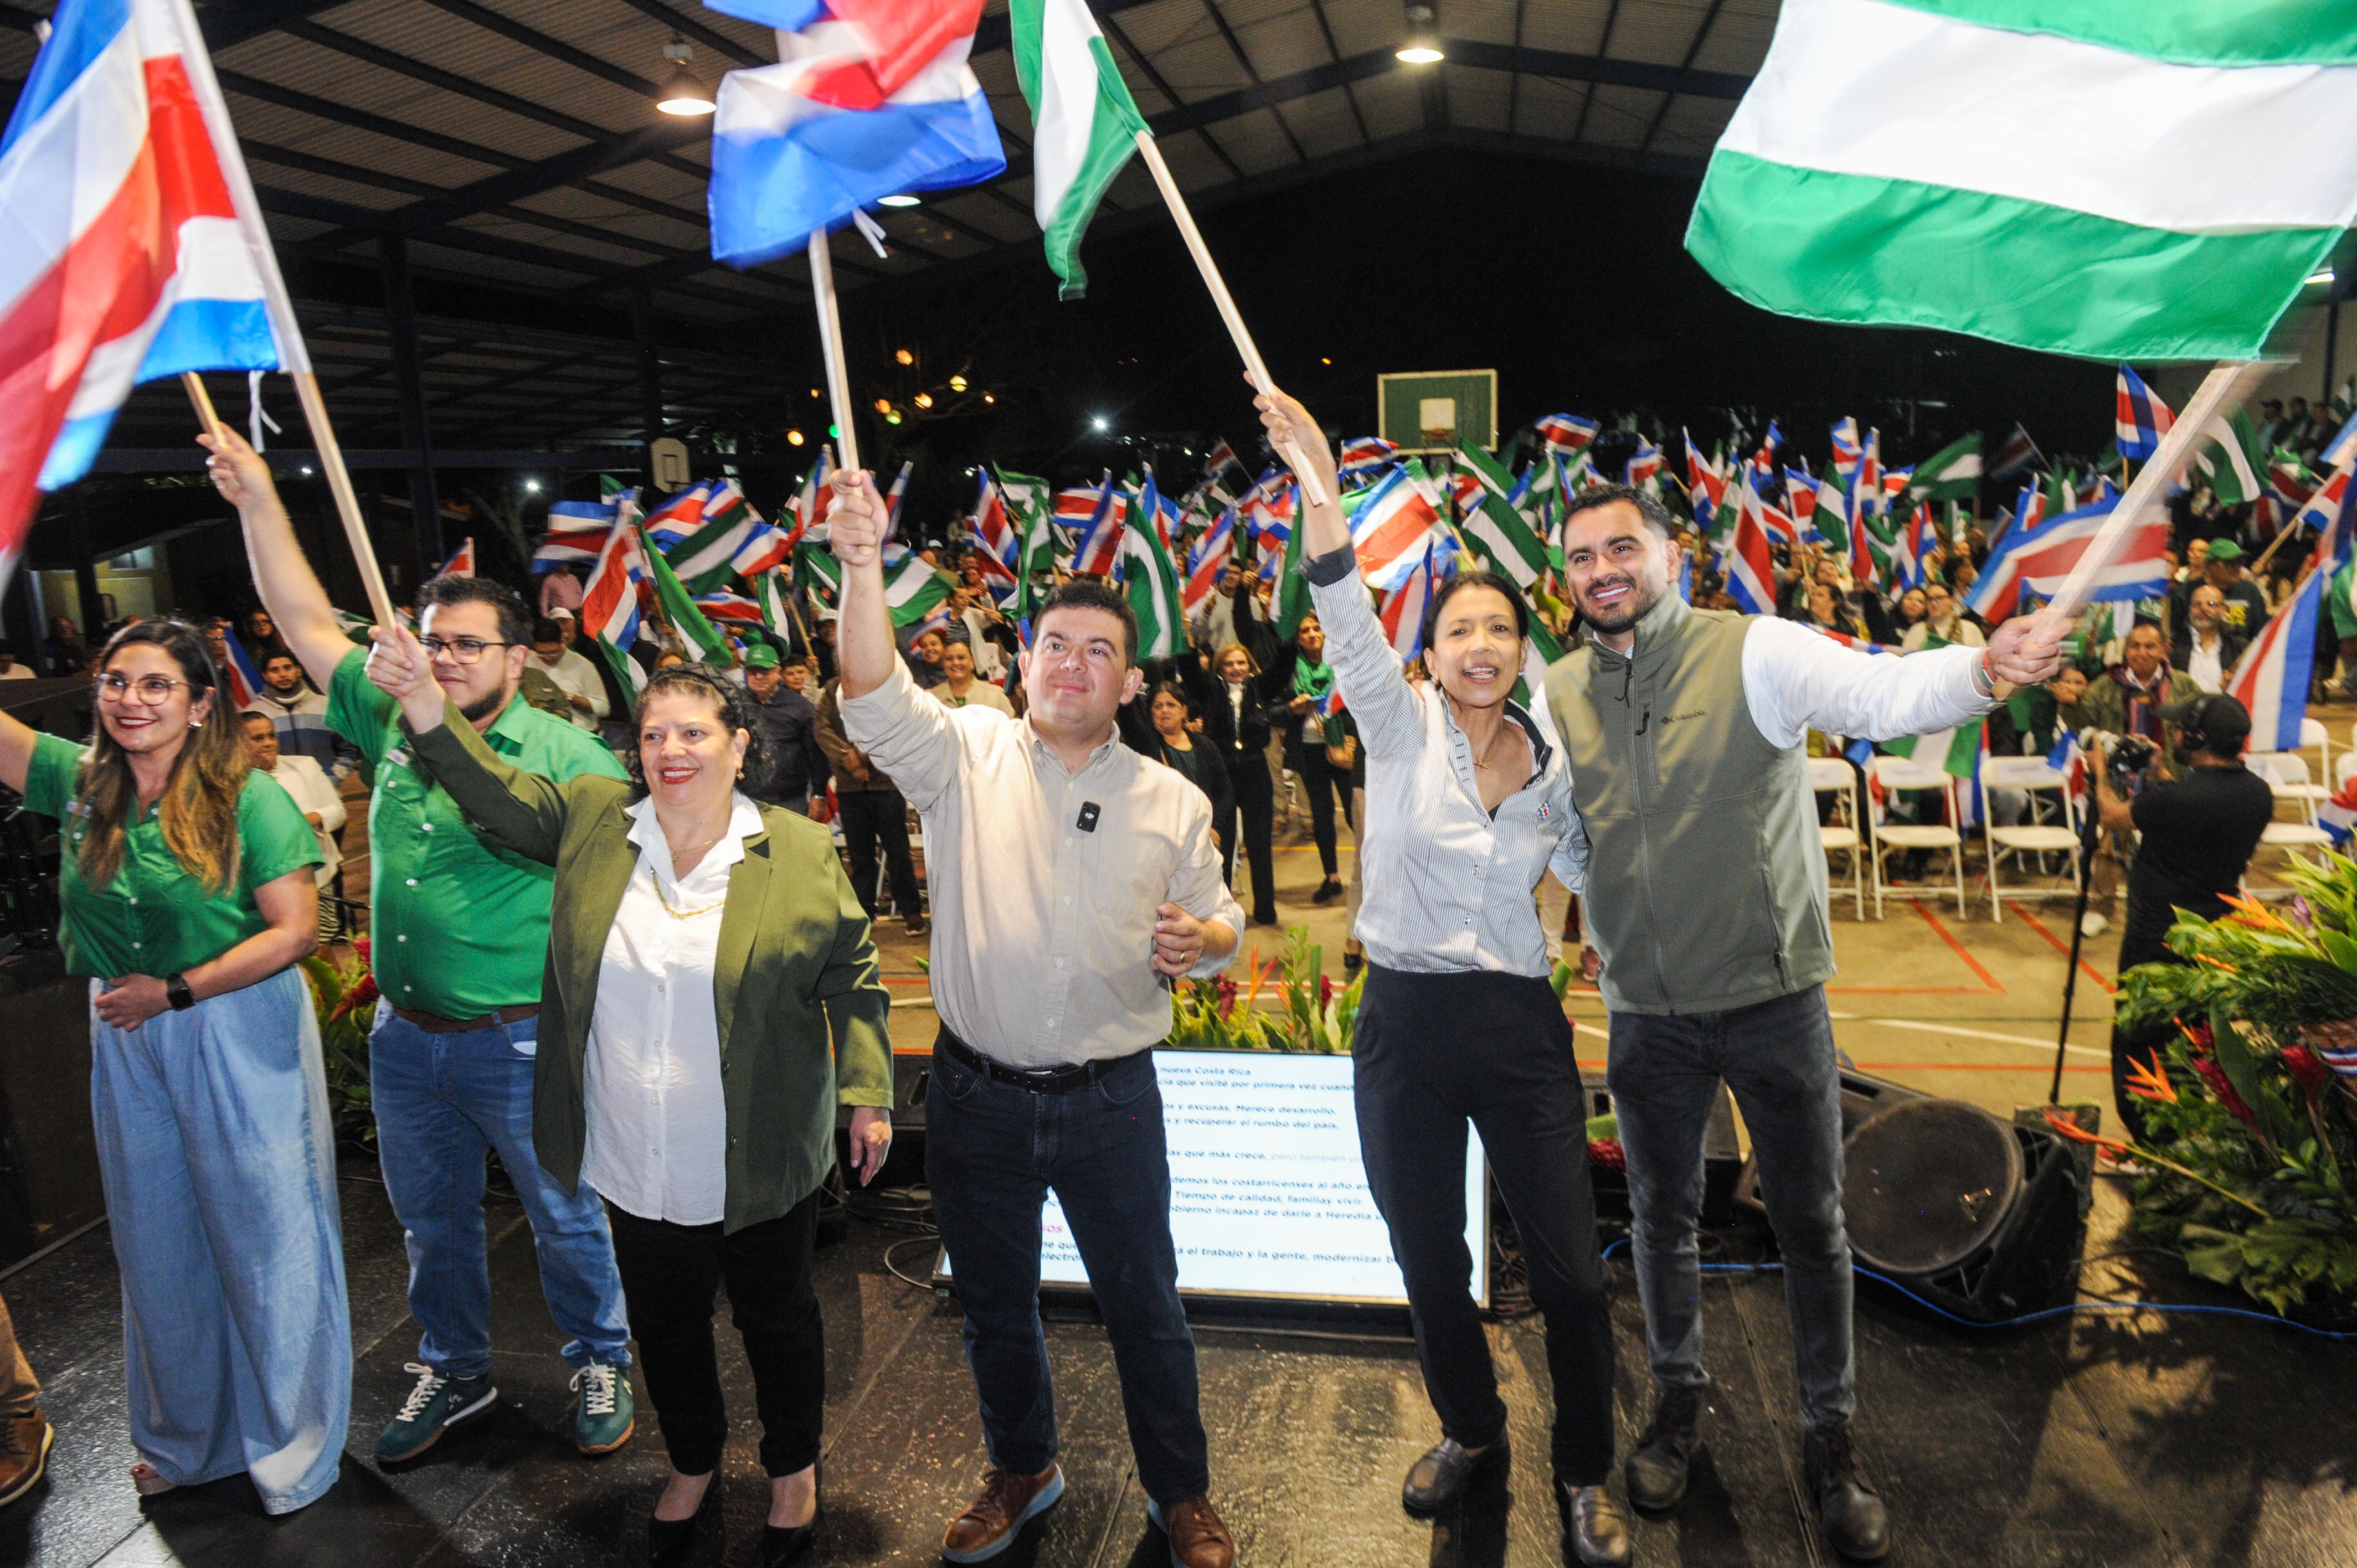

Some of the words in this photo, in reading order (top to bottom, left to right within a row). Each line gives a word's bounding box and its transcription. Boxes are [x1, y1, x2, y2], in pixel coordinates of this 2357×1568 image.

[1195, 1066, 1224, 1075] Costa
[1228, 1067, 1252, 1076] Rica
[1253, 1081, 1295, 1089] primera
[1187, 1104, 1231, 1112] excusas.
[1236, 1104, 1275, 1113] Merece
[1278, 1106, 1337, 1115] desarrollo.
[1208, 1150, 1231, 1158] más
[1234, 1152, 1267, 1160] crece,
[1212, 1177, 1228, 1185] los
[1232, 1179, 1314, 1188] costarricenses
[1331, 1182, 1352, 1190] año
[1175, 1190, 1217, 1200] Tiempo
[1239, 1194, 1283, 1204] calidad,
[1216, 1207, 1259, 1215] incapaz
[1282, 1209, 1311, 1218] darle
[1326, 1211, 1371, 1220] Heredia
[1202, 1248, 1243, 1258] trabajo
[1272, 1252, 1309, 1260] gente,
[1313, 1253, 1382, 1263] modernizar
